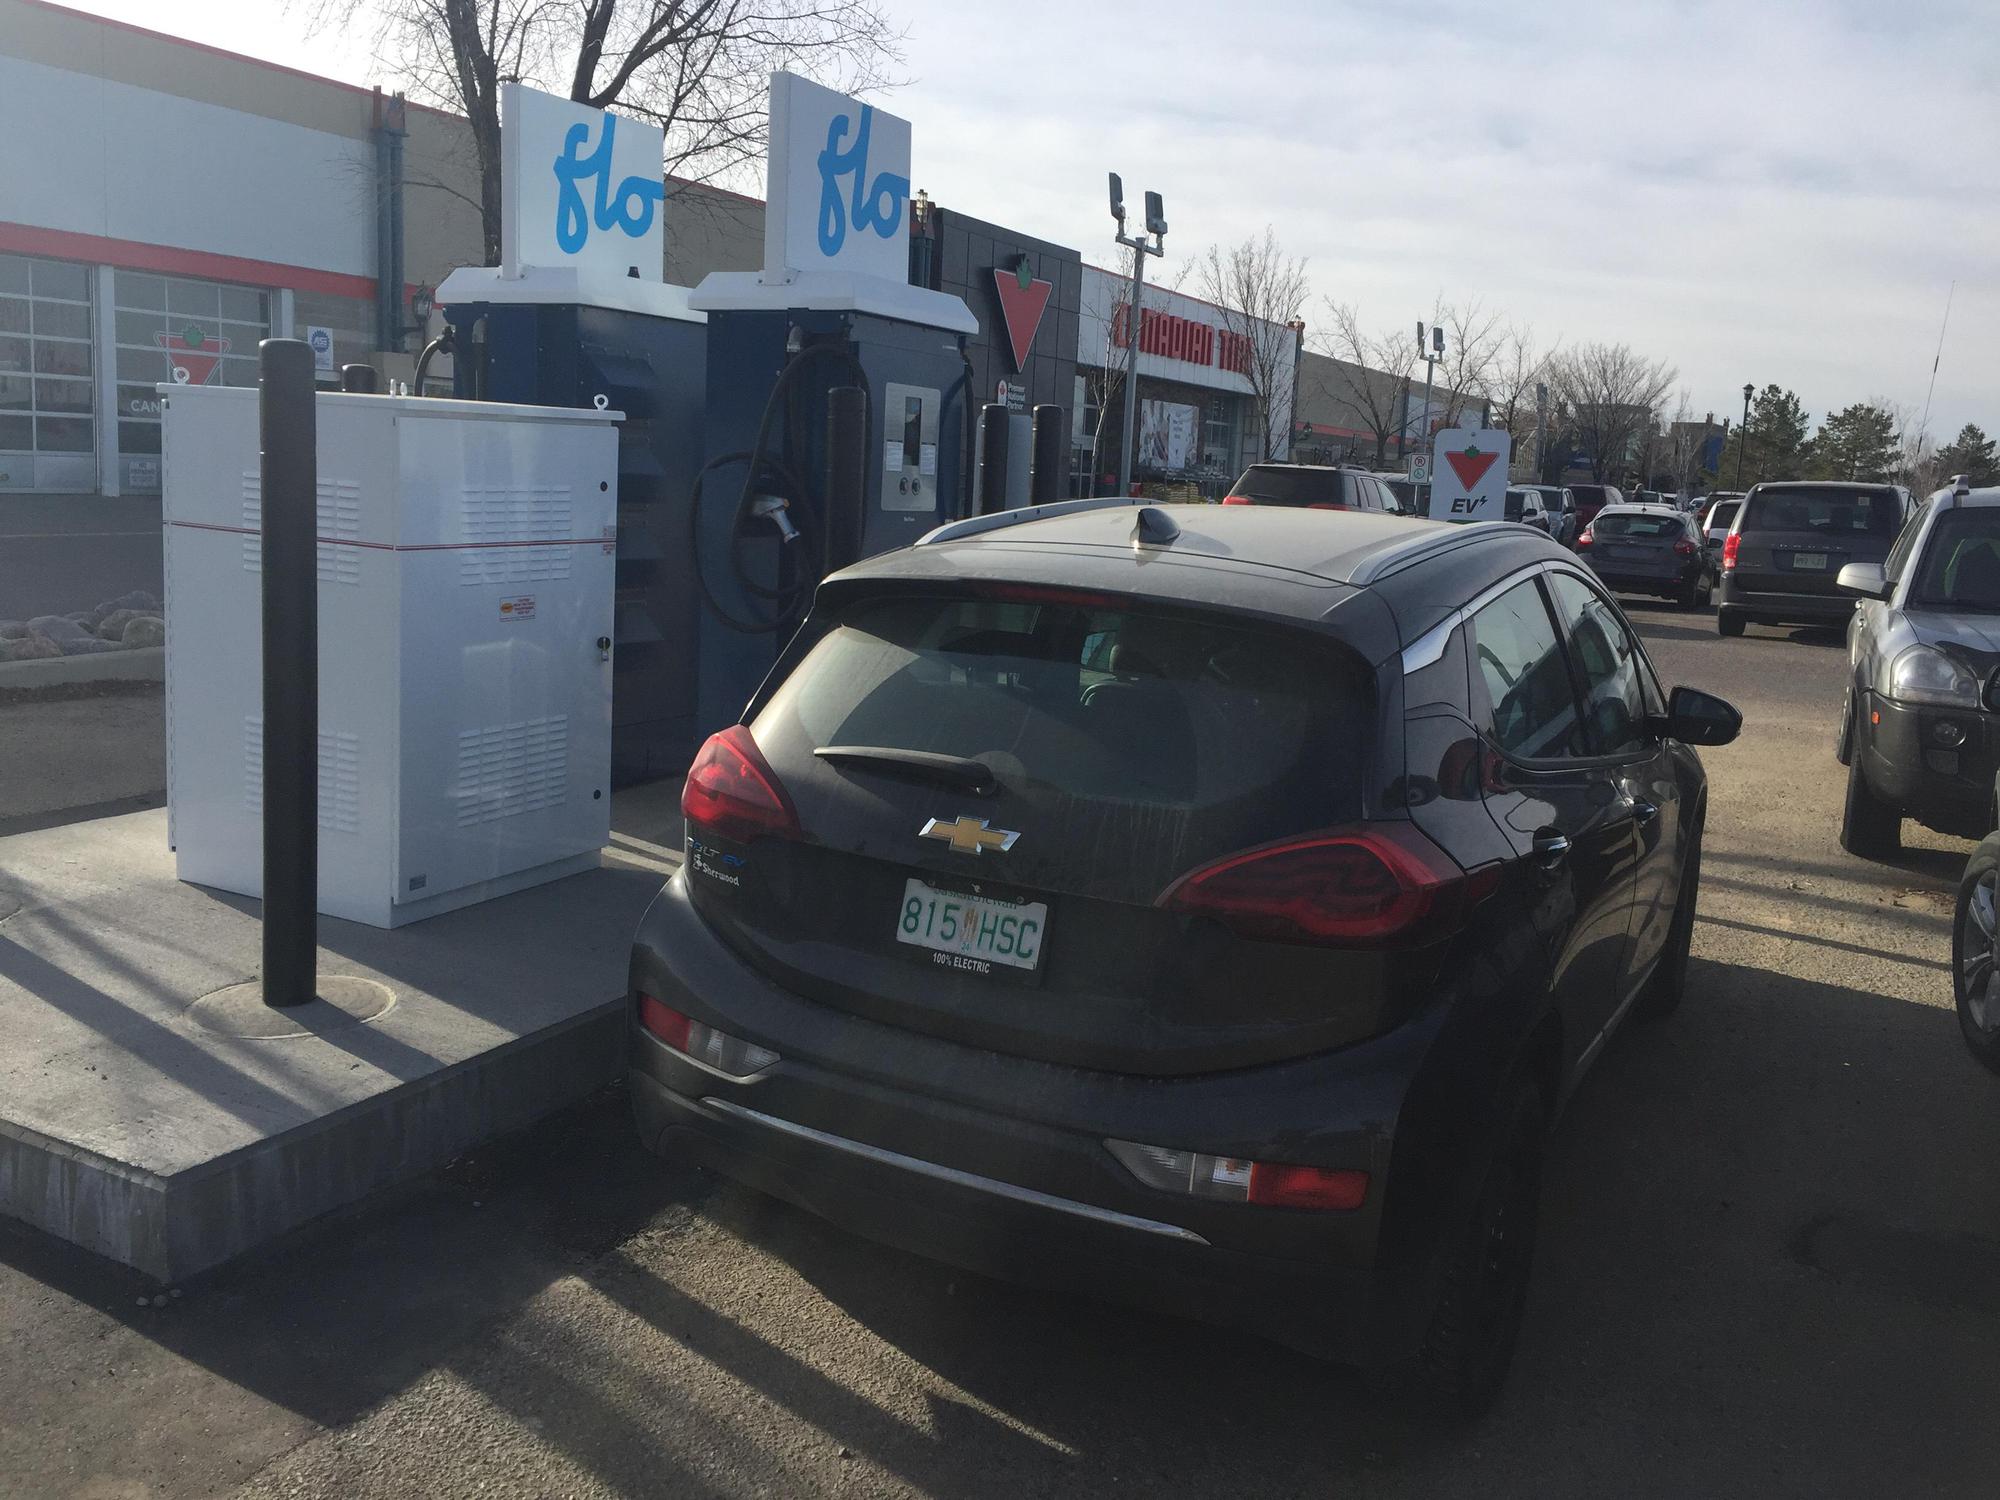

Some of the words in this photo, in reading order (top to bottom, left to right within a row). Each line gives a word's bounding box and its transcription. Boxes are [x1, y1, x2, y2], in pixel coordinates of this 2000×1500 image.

[553, 111, 665, 255] flo
[817, 104, 911, 257] flo
[1113, 302, 1215, 366] CNADIAN
[1450, 498, 1479, 514] EV
[702, 863, 740, 887] Sherwood
[902, 896, 962, 942] 815
[977, 911, 1038, 959] HSC
[932, 952, 952, 967] 100%
[953, 956, 990, 974] ELECTRIC
